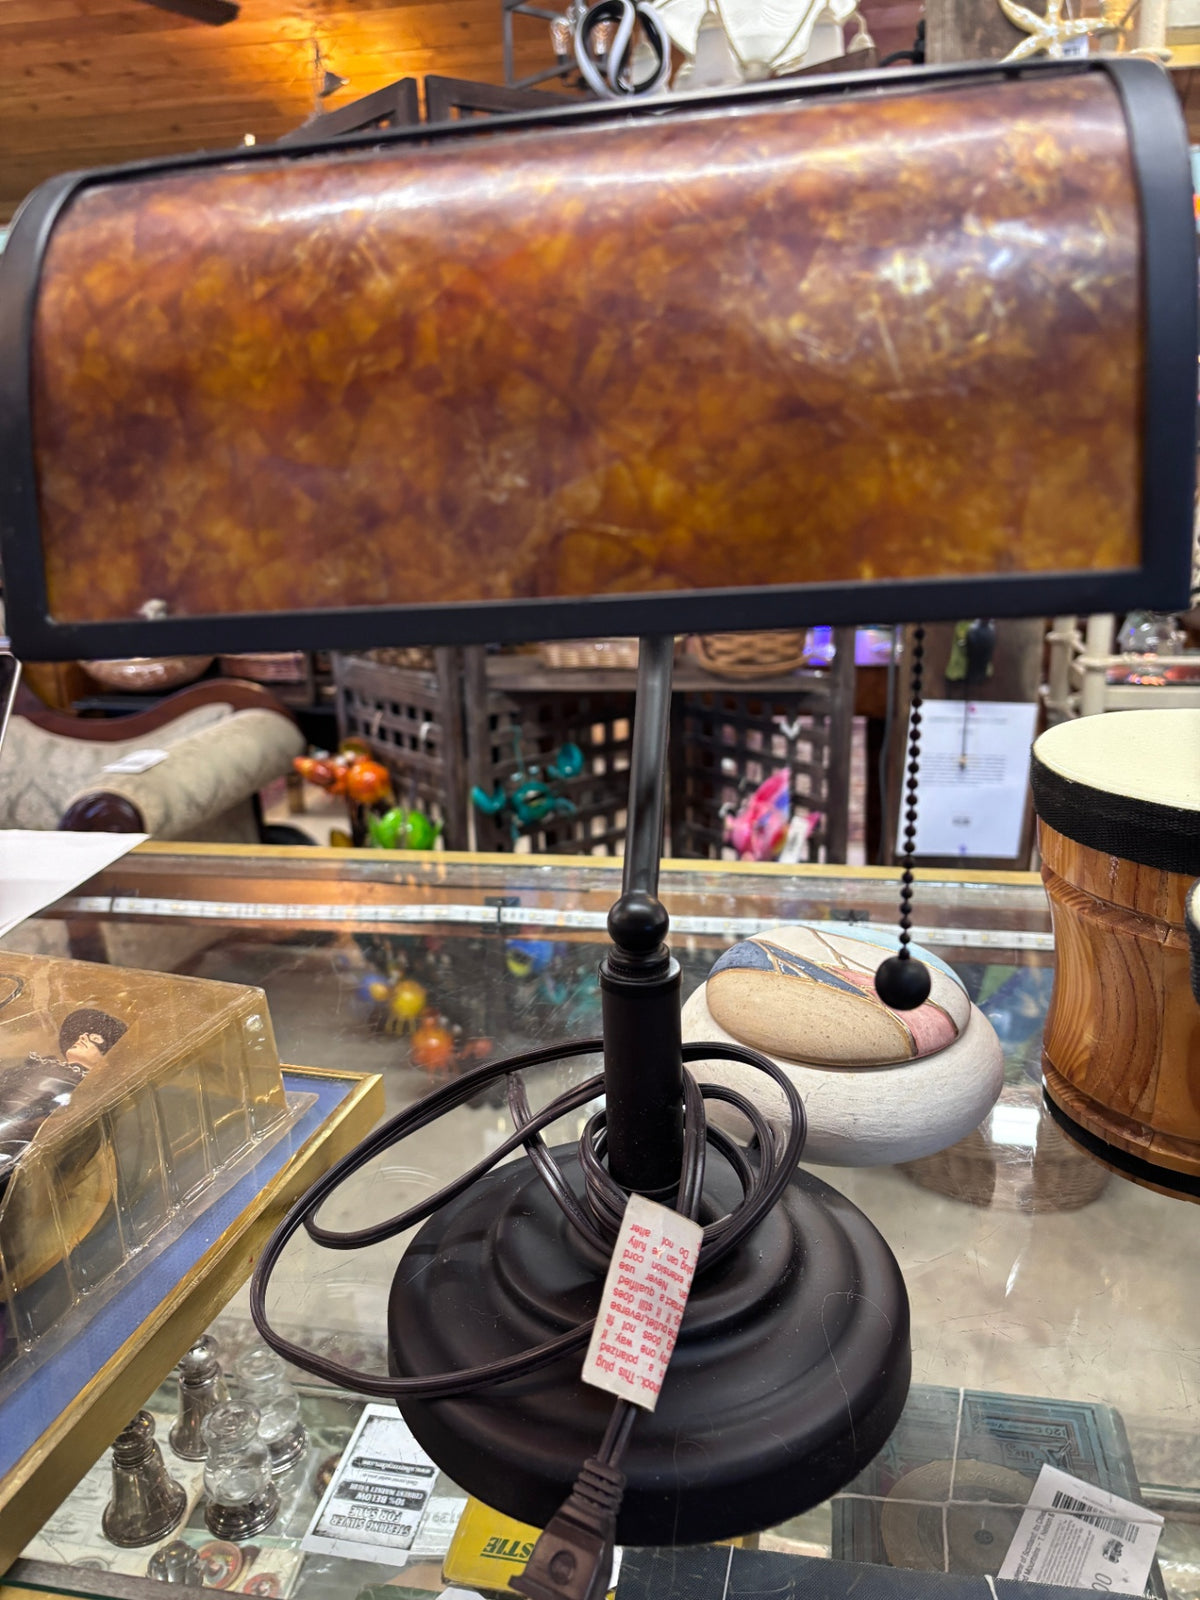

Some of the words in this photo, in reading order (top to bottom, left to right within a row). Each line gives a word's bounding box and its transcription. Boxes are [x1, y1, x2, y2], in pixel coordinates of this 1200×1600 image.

[629, 1224, 651, 1237] alter
[628, 1236, 646, 1252] fully
[661, 1238, 674, 1248] not
[622, 1249, 644, 1263] cord
[666, 1255, 678, 1266] can
[679, 1248, 688, 1260] Do
[618, 1261, 635, 1273] use
[651, 1262, 684, 1284] extension
[680, 1260, 694, 1274] plug
[617, 1275, 654, 1296] qualified
[645, 1274, 667, 1291] Never
[612, 1287, 634, 1304] does
[659, 1294, 665, 1302] a
[638, 1300, 653, 1312] still
[664, 1297, 684, 1313] ontact
[605, 1314, 615, 1327] fit
[621, 1321, 635, 1333] not
[616, 1333, 632, 1347] way.
[642, 1330, 662, 1346] does
[666, 1327, 677, 1340] he
[599, 1342, 639, 1365] polarized
[640, 1345, 656, 1358] one
[659, 1352, 669, 1365] nly
[595, 1354, 616, 1372] plug
[648, 1364, 654, 1372] a
[618, 1367, 635, 1385] This
[641, 1377, 660, 1394] hock.
[354, 1490, 388, 1504] BELOW
[370, 1485, 395, 1495] MARKET
[387, 1495, 405, 1506] 10%
[349, 1504, 379, 1520] SALE
[378, 1509, 402, 1523] FOR
[330, 1514, 365, 1530] SILVER
[364, 1520, 411, 1536] STERLING
